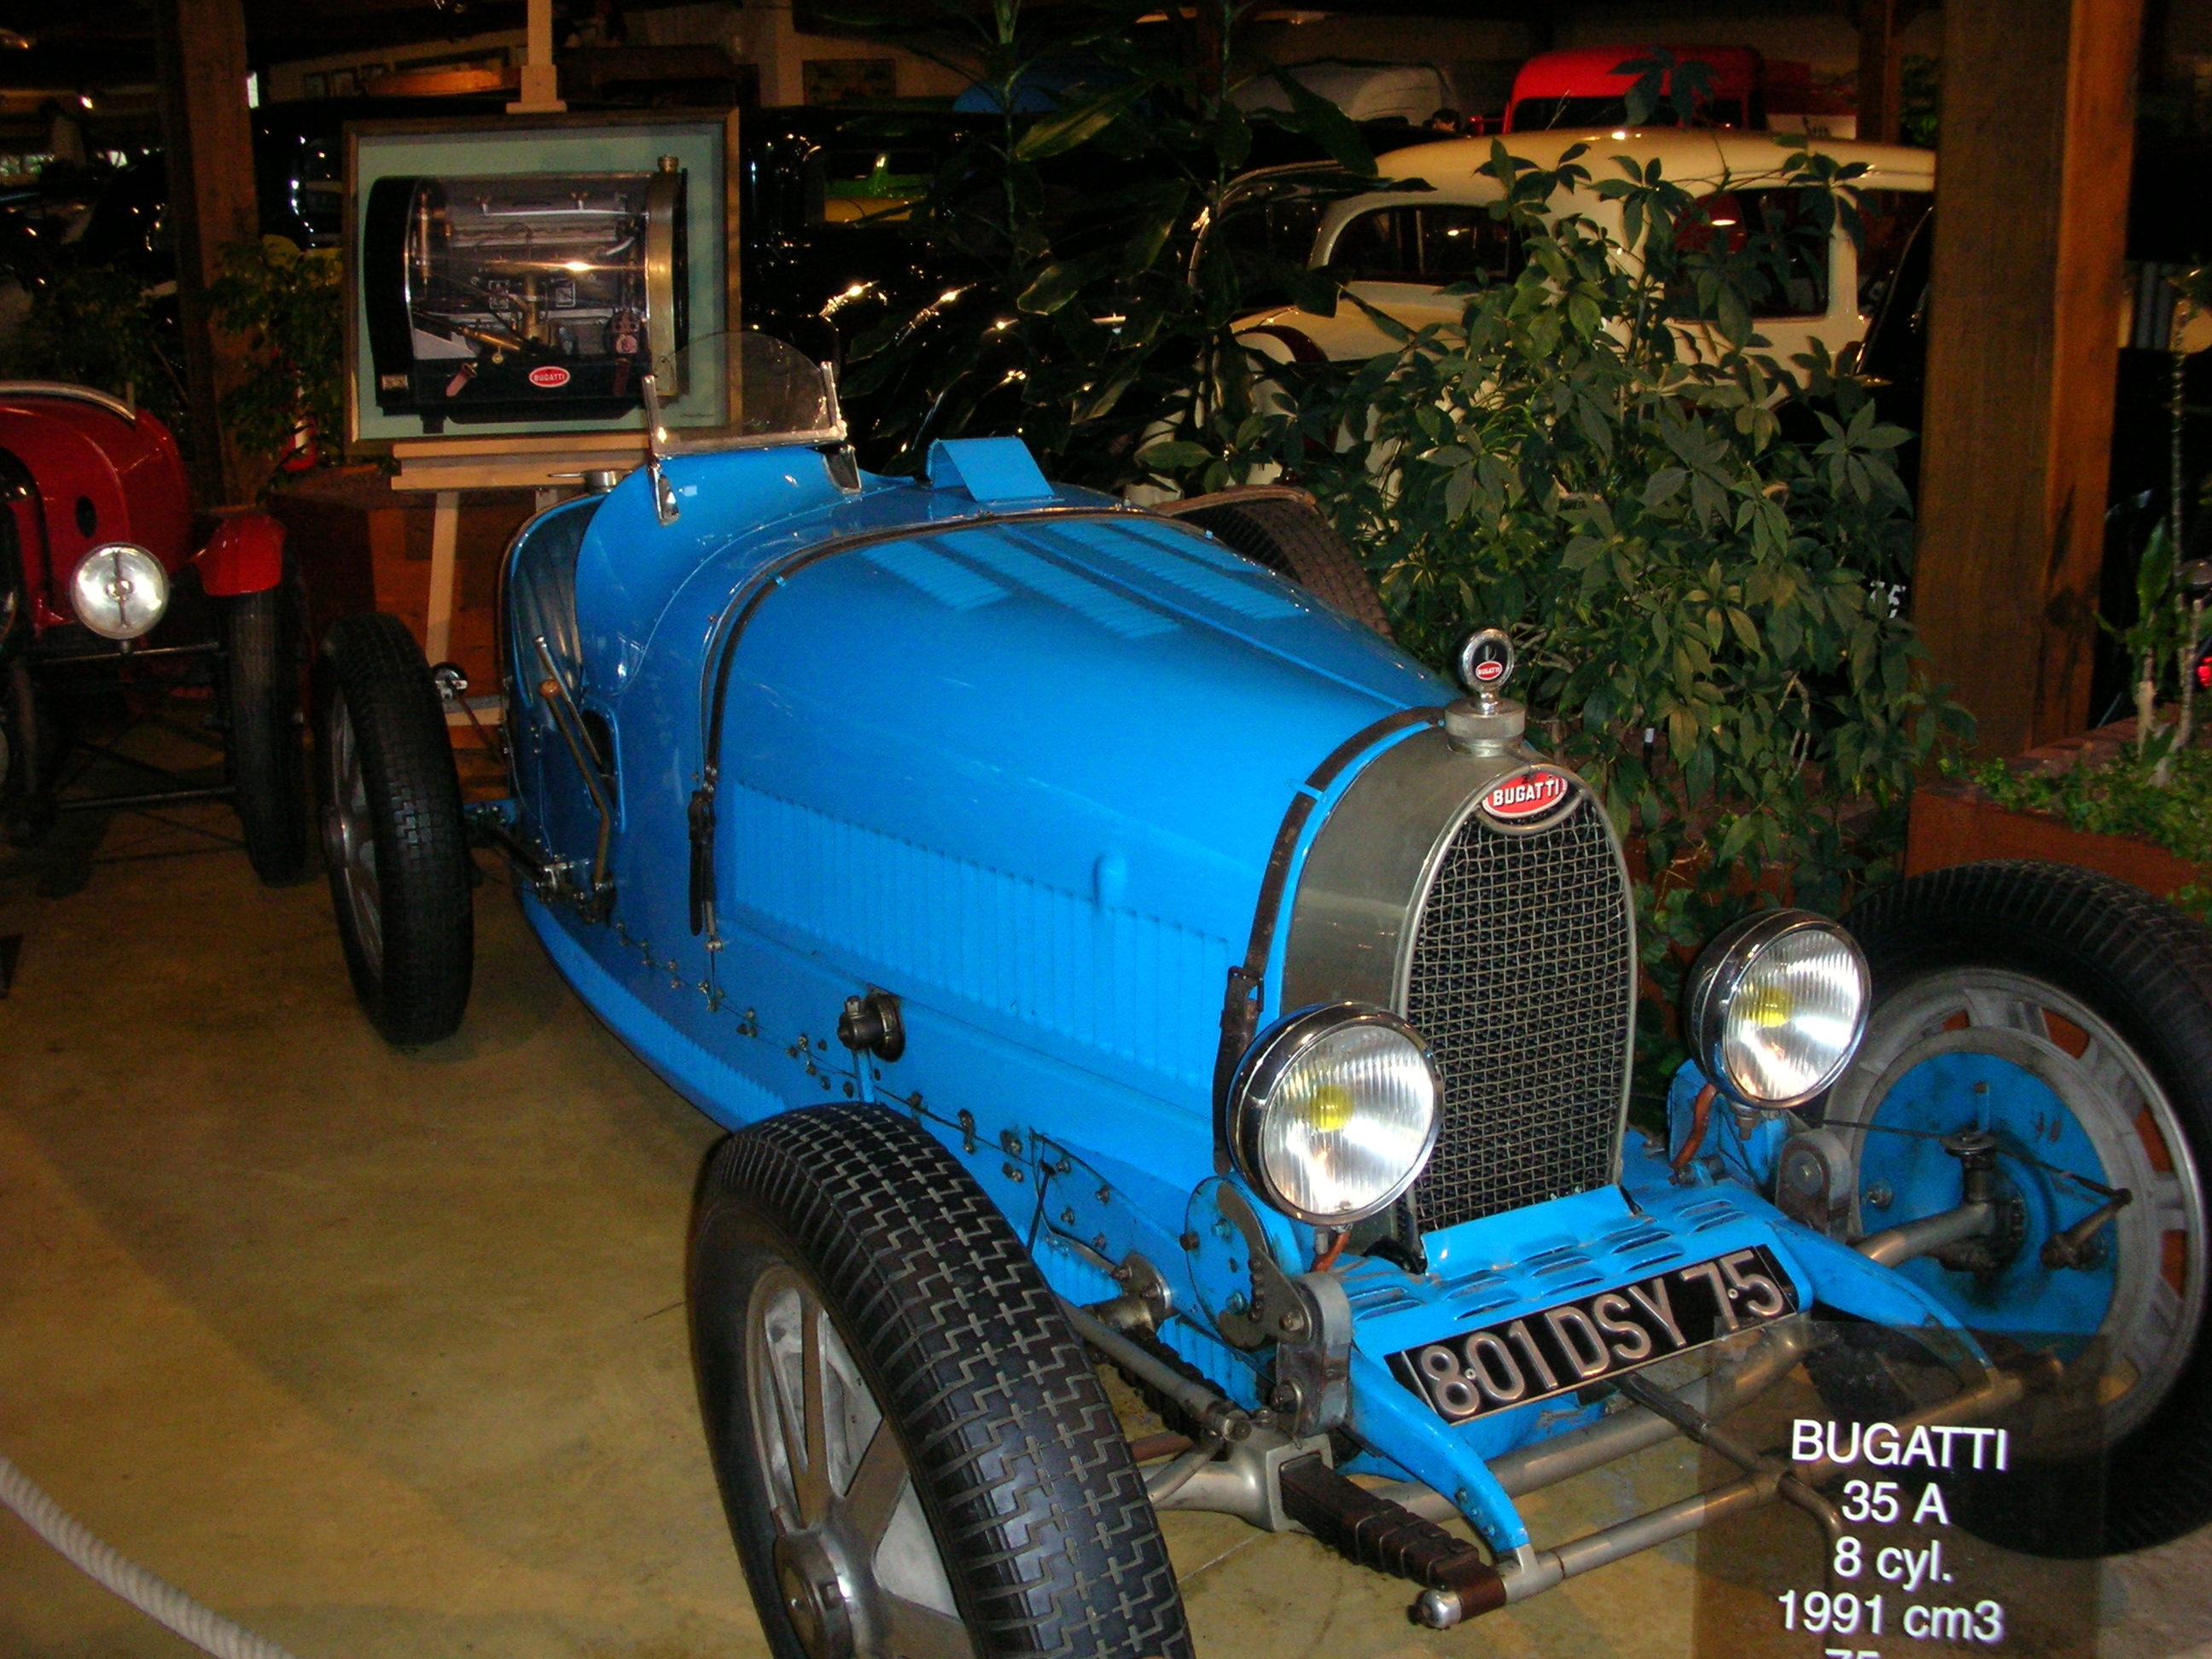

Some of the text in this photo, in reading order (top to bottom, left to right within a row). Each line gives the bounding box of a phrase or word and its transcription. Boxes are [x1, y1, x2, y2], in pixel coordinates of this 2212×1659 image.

[1493, 778, 1560, 807] BUGATTI
[1420, 1249, 1784, 1417] 801 DSY 75
[1792, 1419, 2007, 1471] BUGATTI
[1842, 1480, 1949, 1525] 35 A
[1833, 1536, 1953, 1592] 8 cyl.
[1778, 1589, 2003, 1642] 1991 cm3
